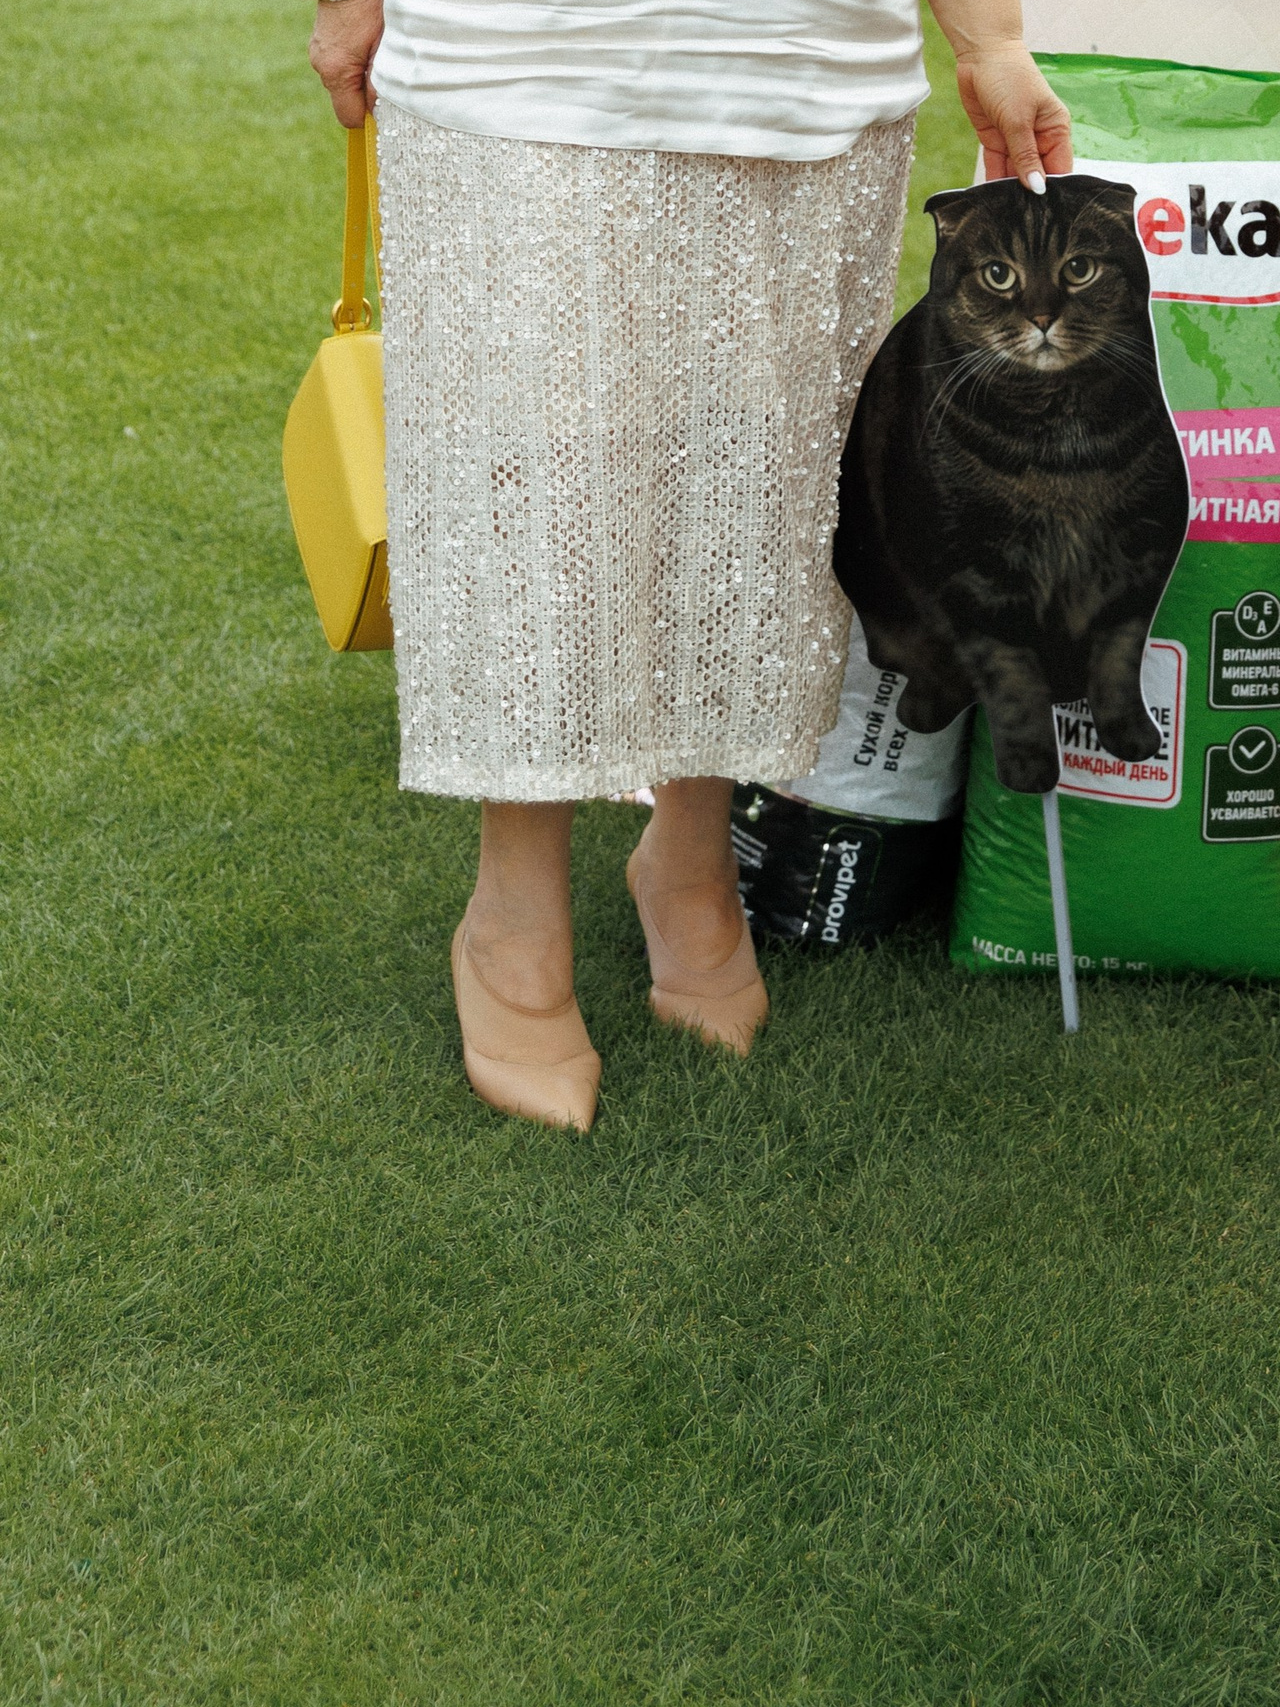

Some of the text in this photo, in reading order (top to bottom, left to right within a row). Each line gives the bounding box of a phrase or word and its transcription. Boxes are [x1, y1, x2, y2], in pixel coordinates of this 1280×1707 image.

[1189, 496, 1280, 524] ИТНАЯ
[1231, 683, 1279, 697] ОМЕГА-6
[853, 672, 900, 767] Сухой кор
[883, 728, 910, 772] всех
[1063, 752, 1169, 782] КАЖДЫЙ ДЕНЬ
[1225, 788, 1275, 803] ХОРОШО
[820, 840, 863, 943] provipet
[972, 935, 1027, 965] МАССА
[1031, 950, 1096, 970] НЕО:
